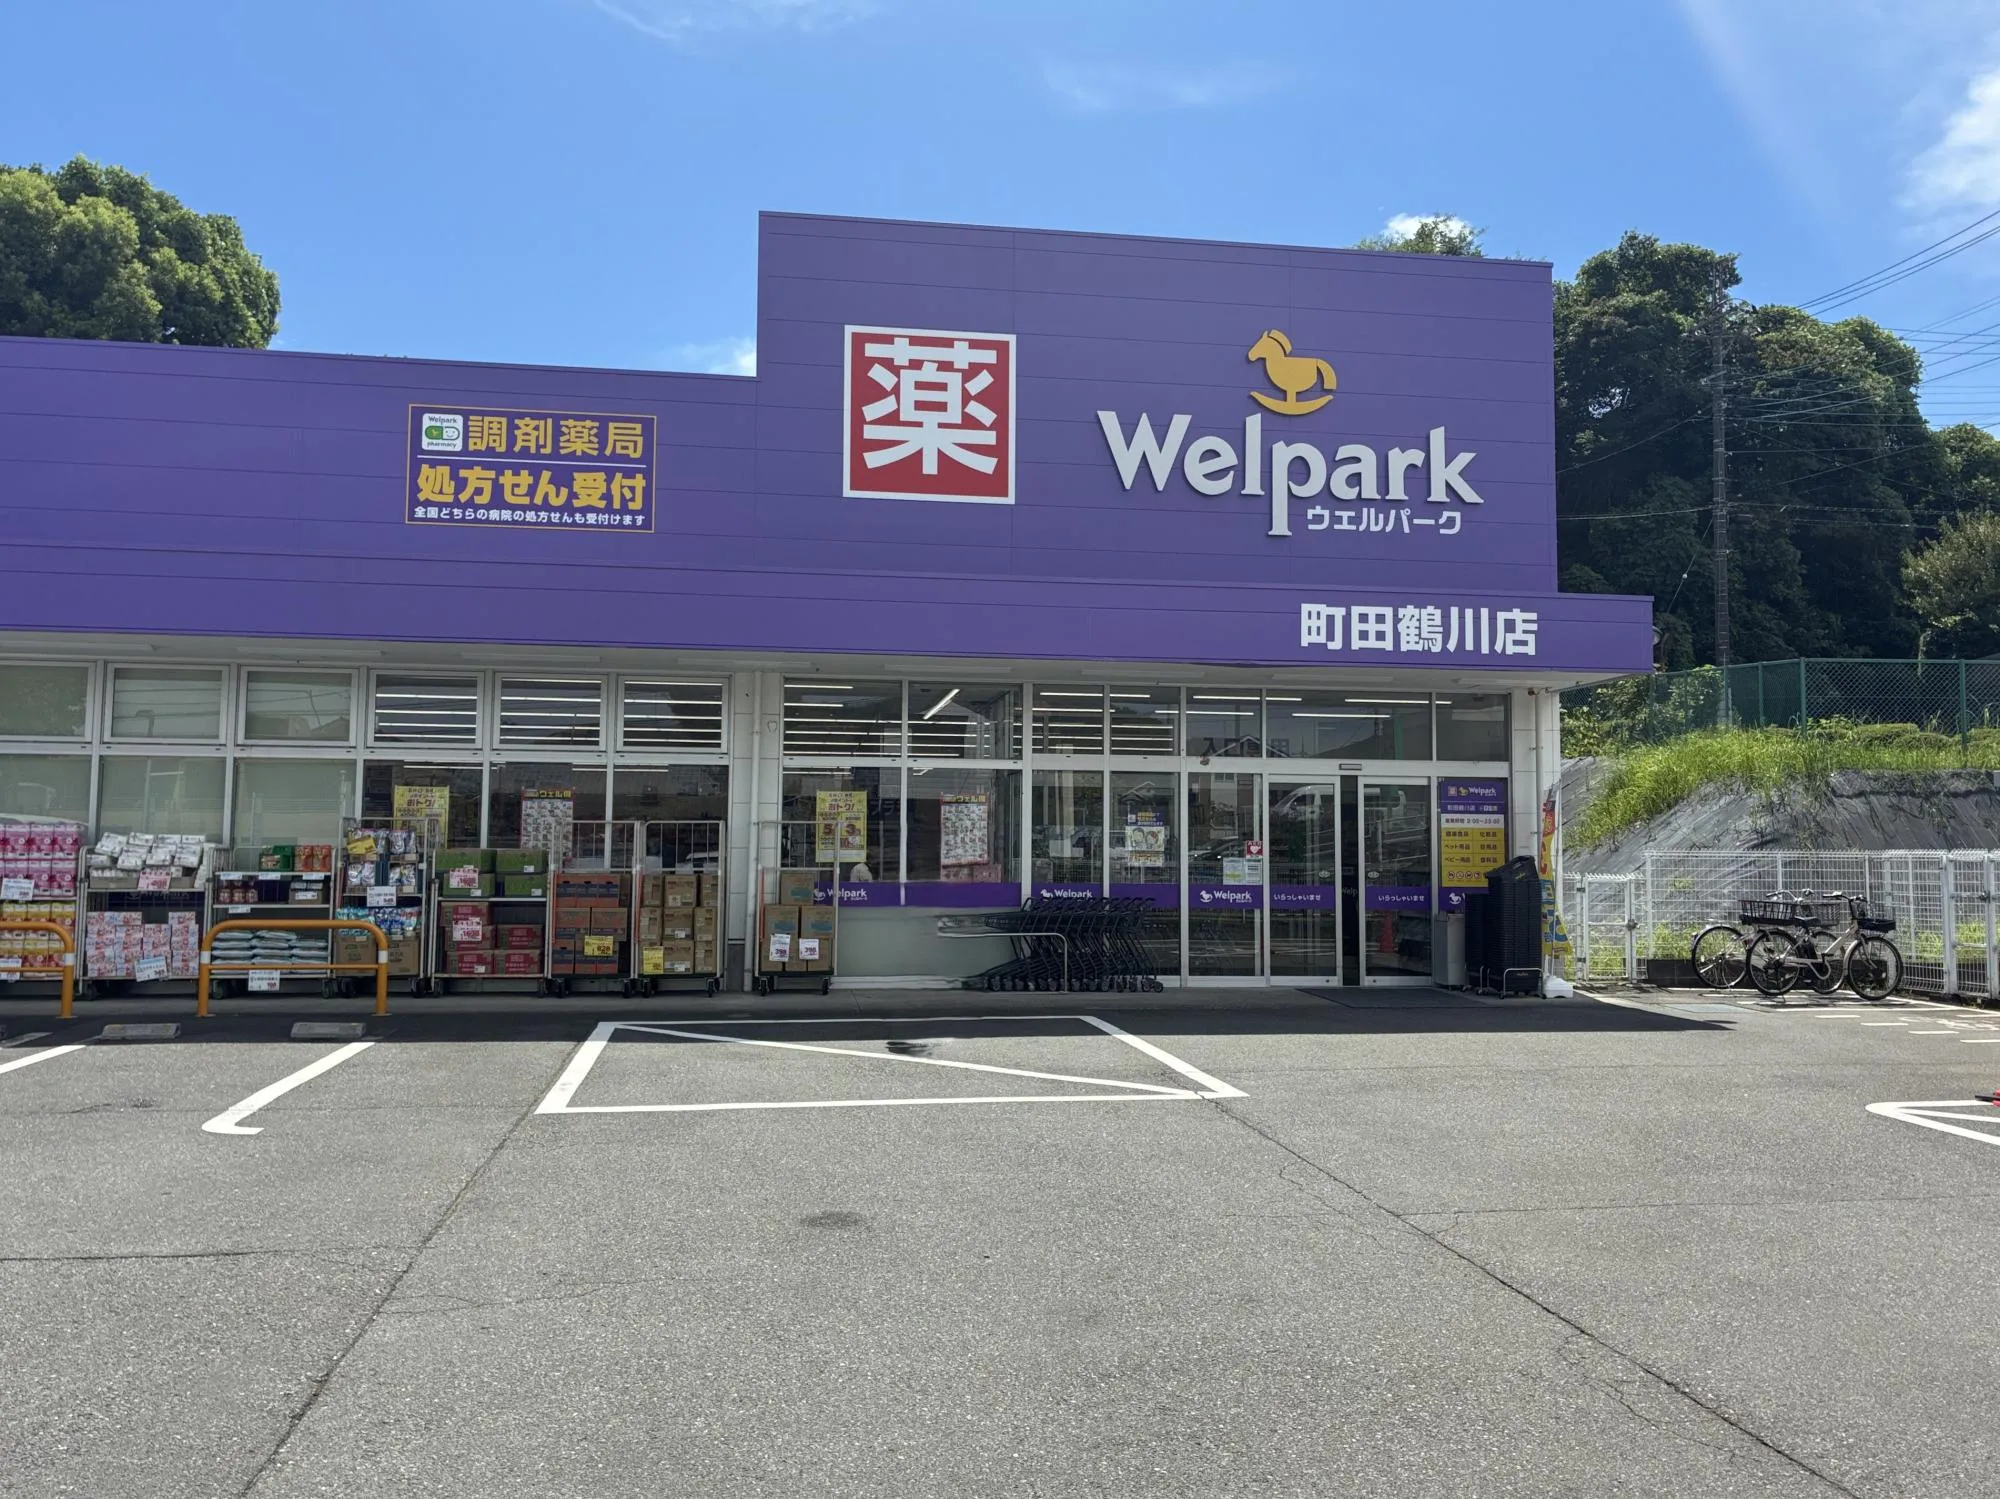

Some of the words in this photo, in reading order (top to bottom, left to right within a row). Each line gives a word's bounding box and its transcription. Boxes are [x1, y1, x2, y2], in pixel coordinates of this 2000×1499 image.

[428, 415, 457, 425] Welpark
[861, 337, 998, 475] 薬
[467, 415, 643, 459] 調剤薬局
[416, 463, 646, 510] 処方せん受付
[1096, 409, 1484, 537] Welpark
[414, 506, 645, 526] 全国どちらの病院の処方せんも受付けます
[1306, 505, 1463, 536] ウエルパーク
[1300, 602, 1539, 656] 町田鶴川店
[1213, 889, 1251, 904] Welpark
[1273, 893, 1321, 902] いらっしゃいませ
[1378, 894, 1425, 902] いらっしゃいませ
